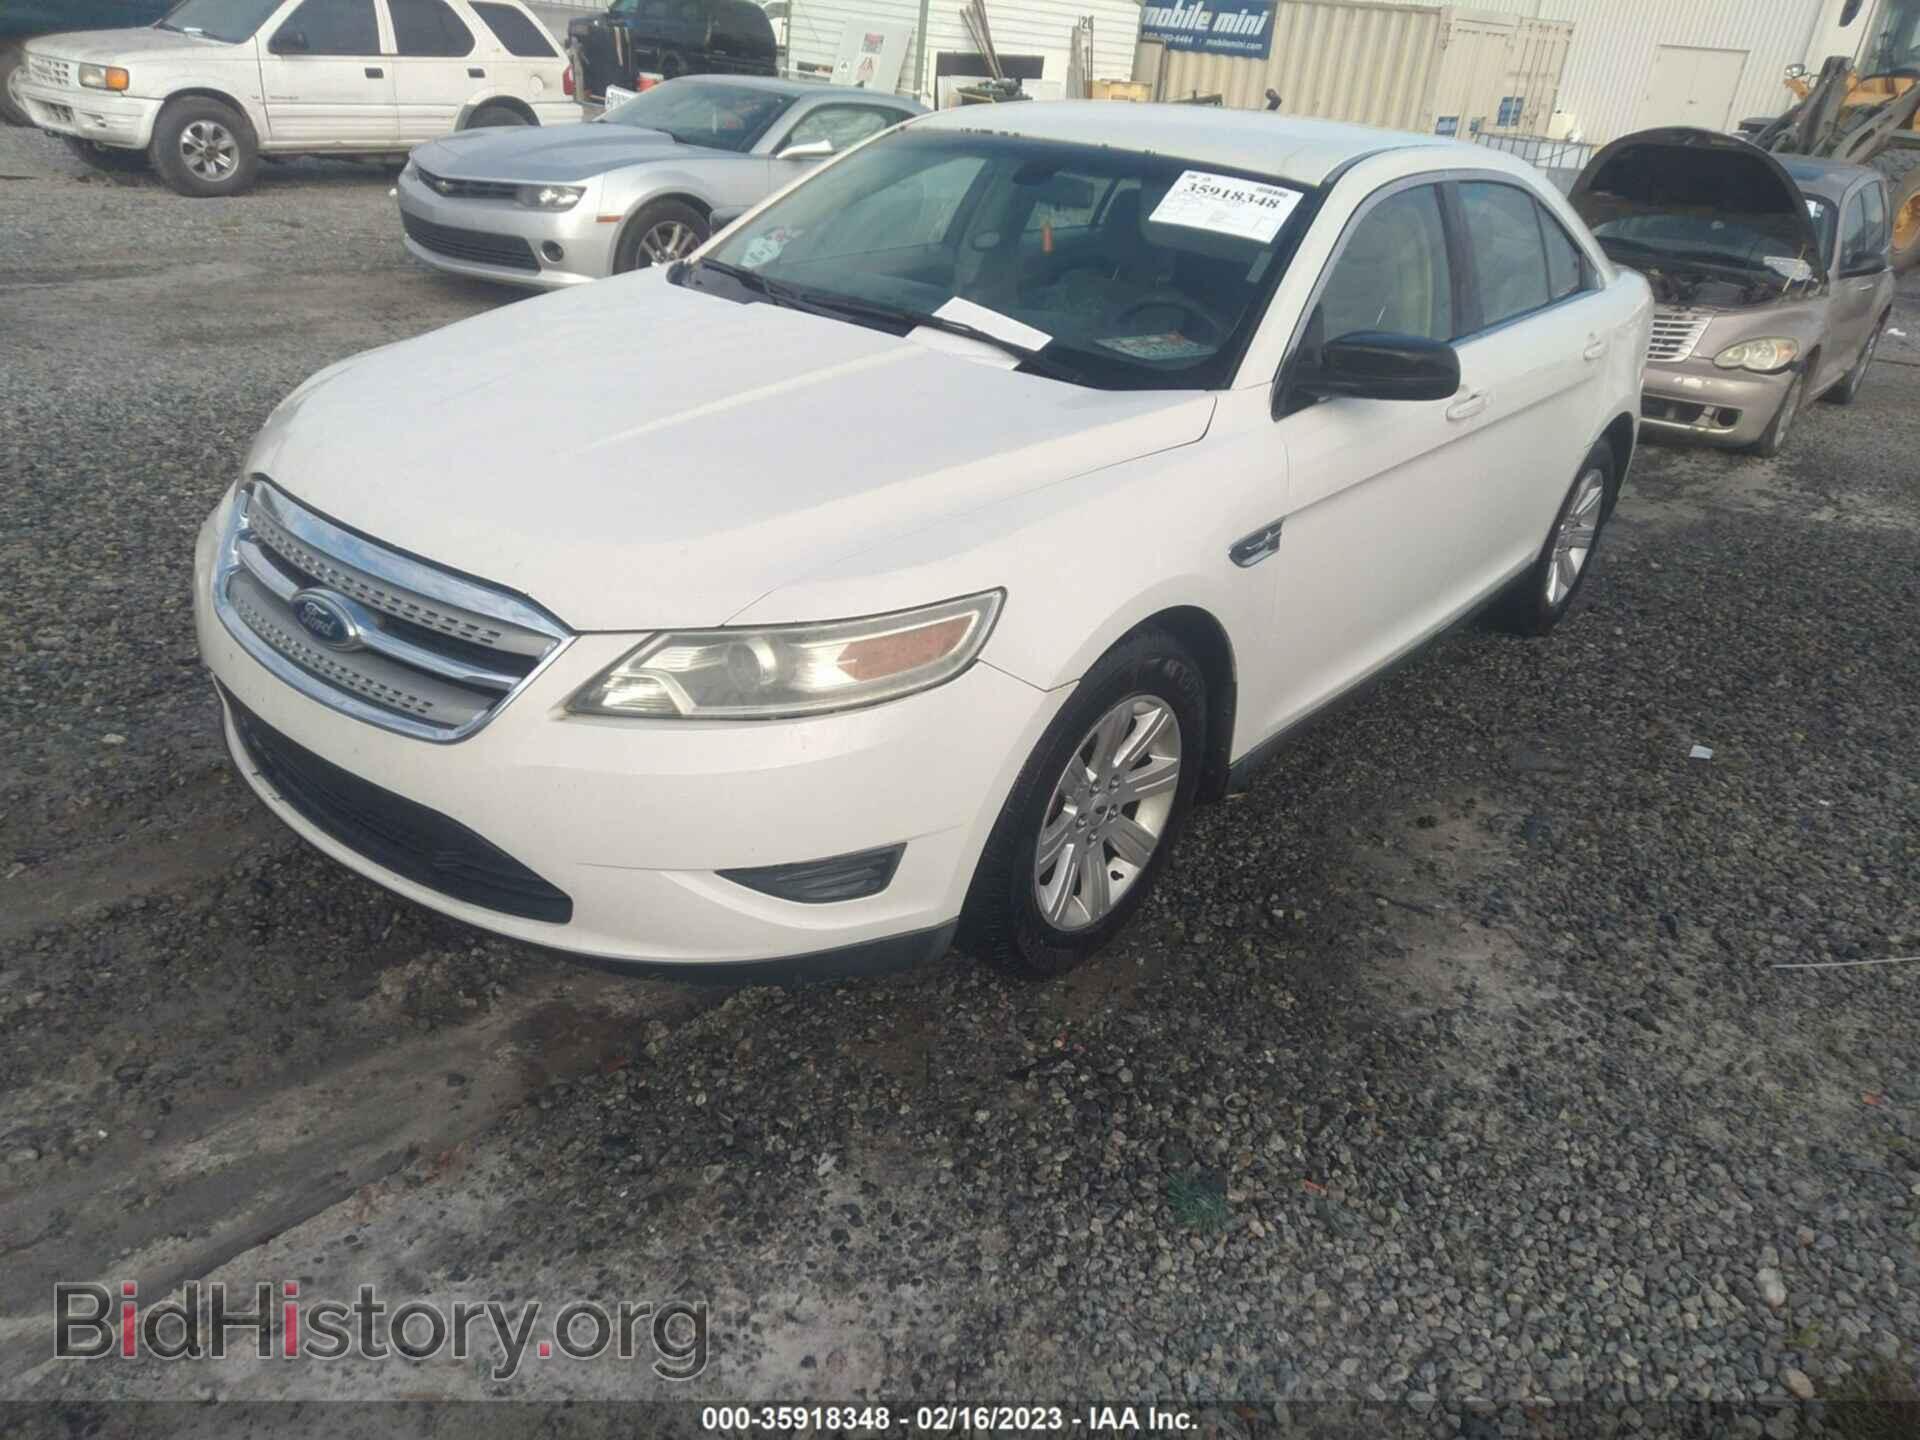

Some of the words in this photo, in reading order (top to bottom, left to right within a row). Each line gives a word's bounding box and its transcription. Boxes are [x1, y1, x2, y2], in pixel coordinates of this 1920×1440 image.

[1212, 9, 1270, 35] mini
[1182, 181, 1281, 209] 35918348
[303, 601, 337, 638] Ford
